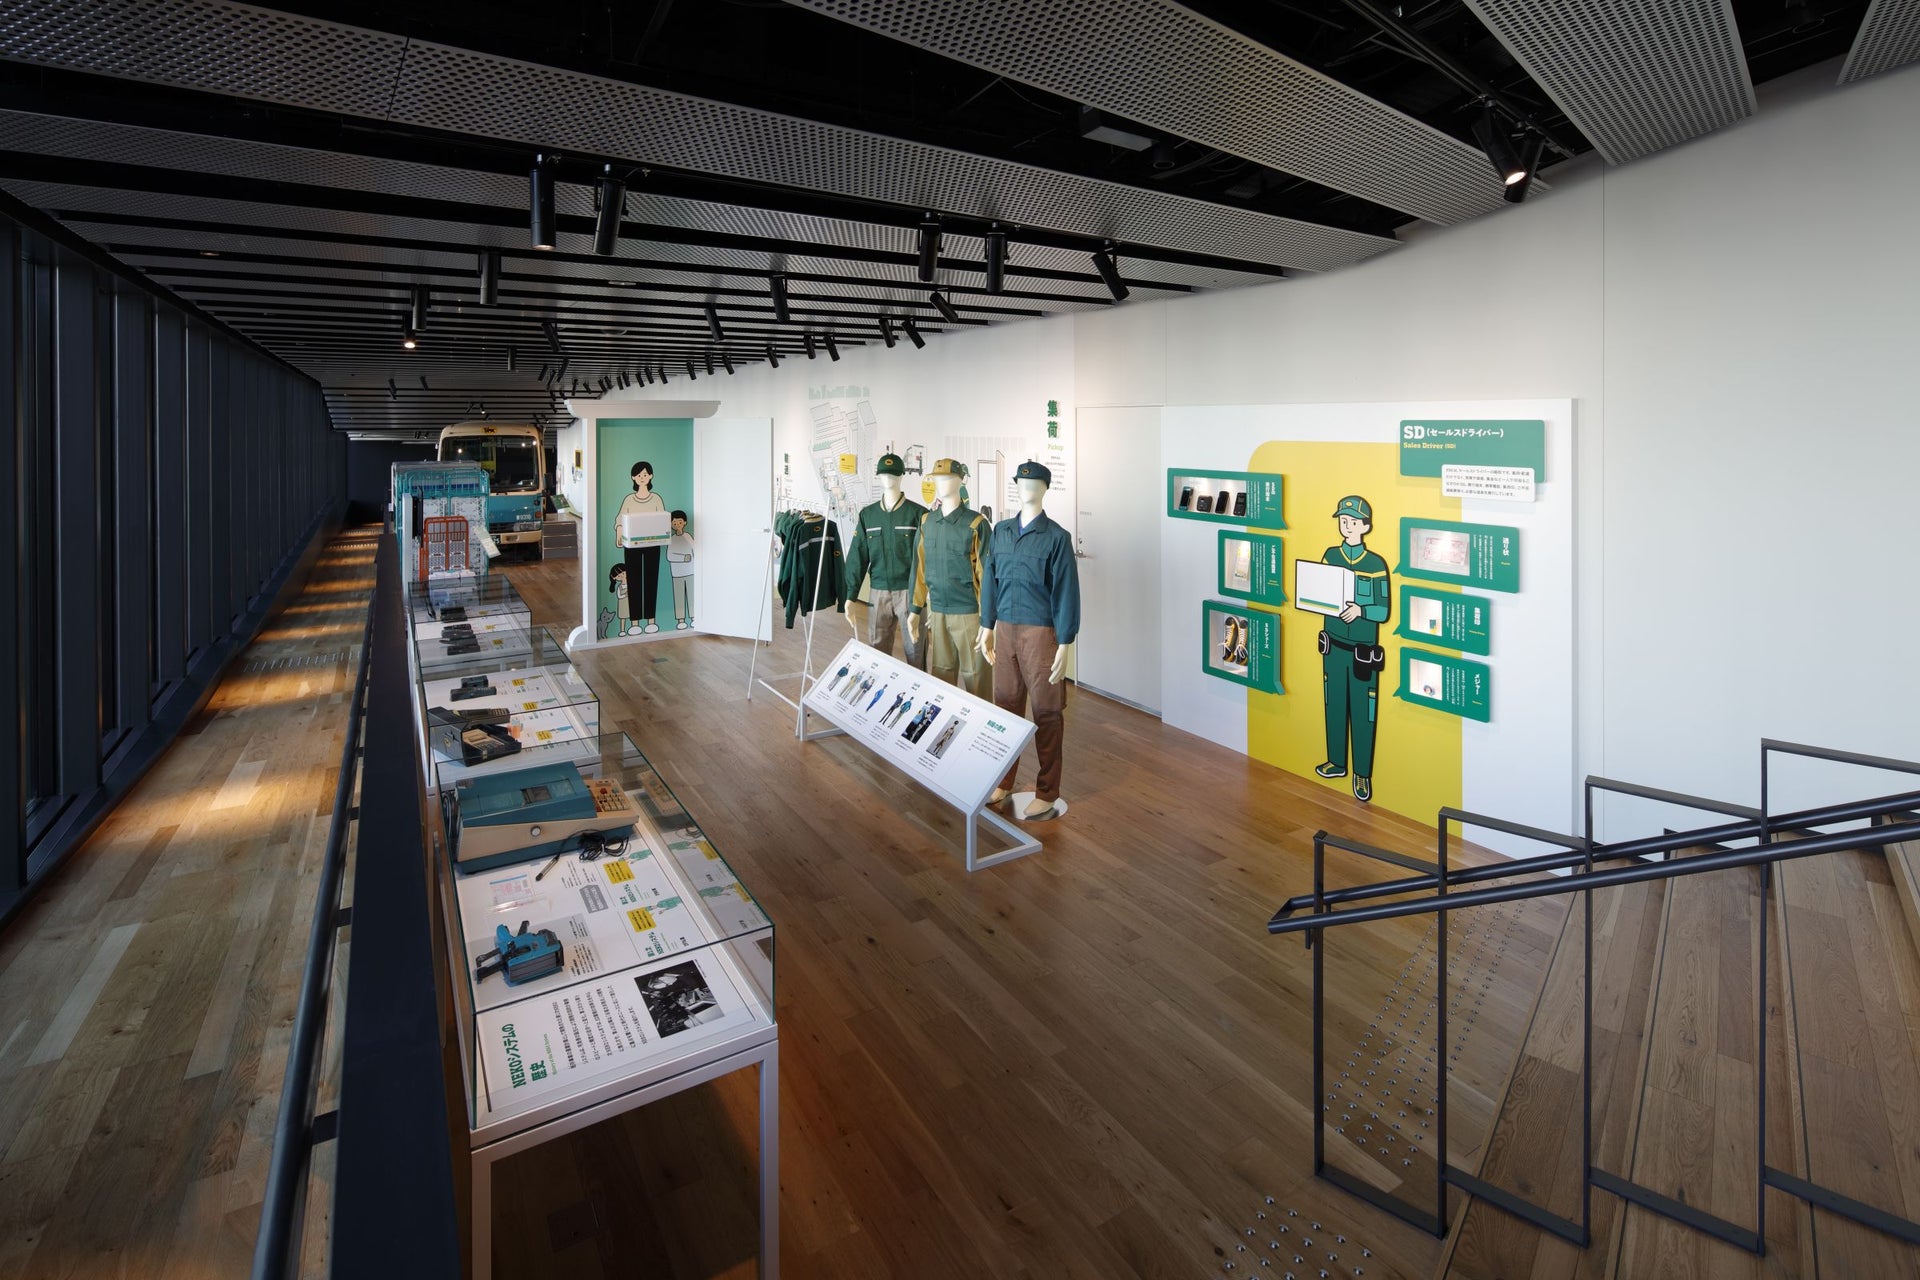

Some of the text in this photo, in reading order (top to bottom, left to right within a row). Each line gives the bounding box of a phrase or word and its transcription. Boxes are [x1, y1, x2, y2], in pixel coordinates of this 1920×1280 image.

[1047, 399, 1058, 438] 集荷
[502, 1023, 527, 1089] NEKOシステムの
[530, 1060, 548, 1081] 歴史
